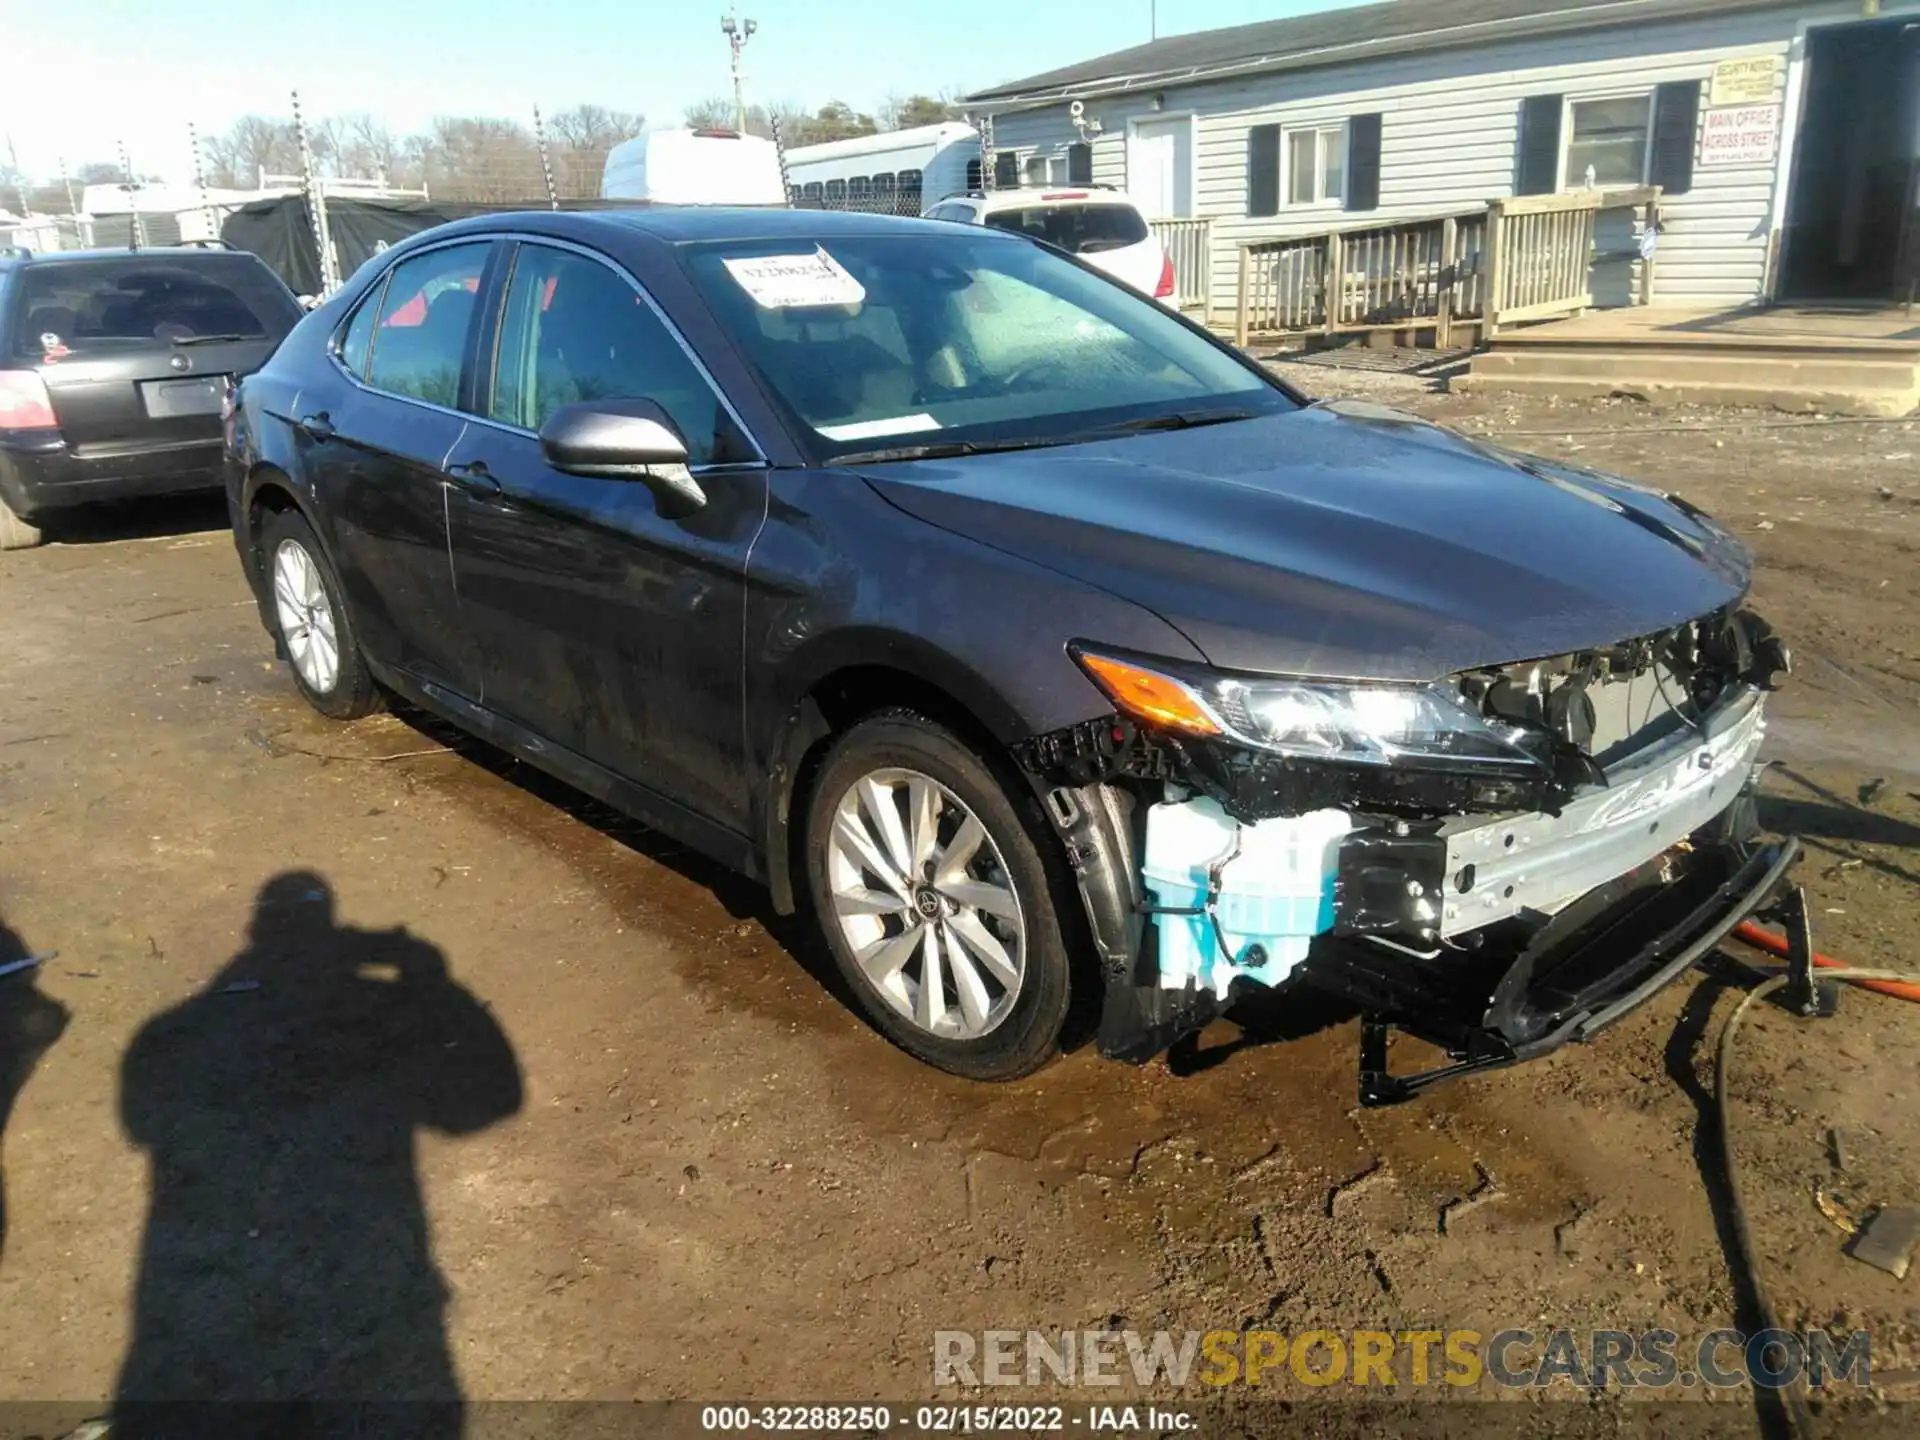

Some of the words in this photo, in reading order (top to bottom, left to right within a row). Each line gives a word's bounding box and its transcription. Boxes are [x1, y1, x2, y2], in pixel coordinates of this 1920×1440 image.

[1709, 112, 1735, 129] MAIN
[1736, 109, 1774, 128] OFFICE
[1704, 132, 1740, 149] ACROSS
[1741, 130, 1774, 147] STREET
